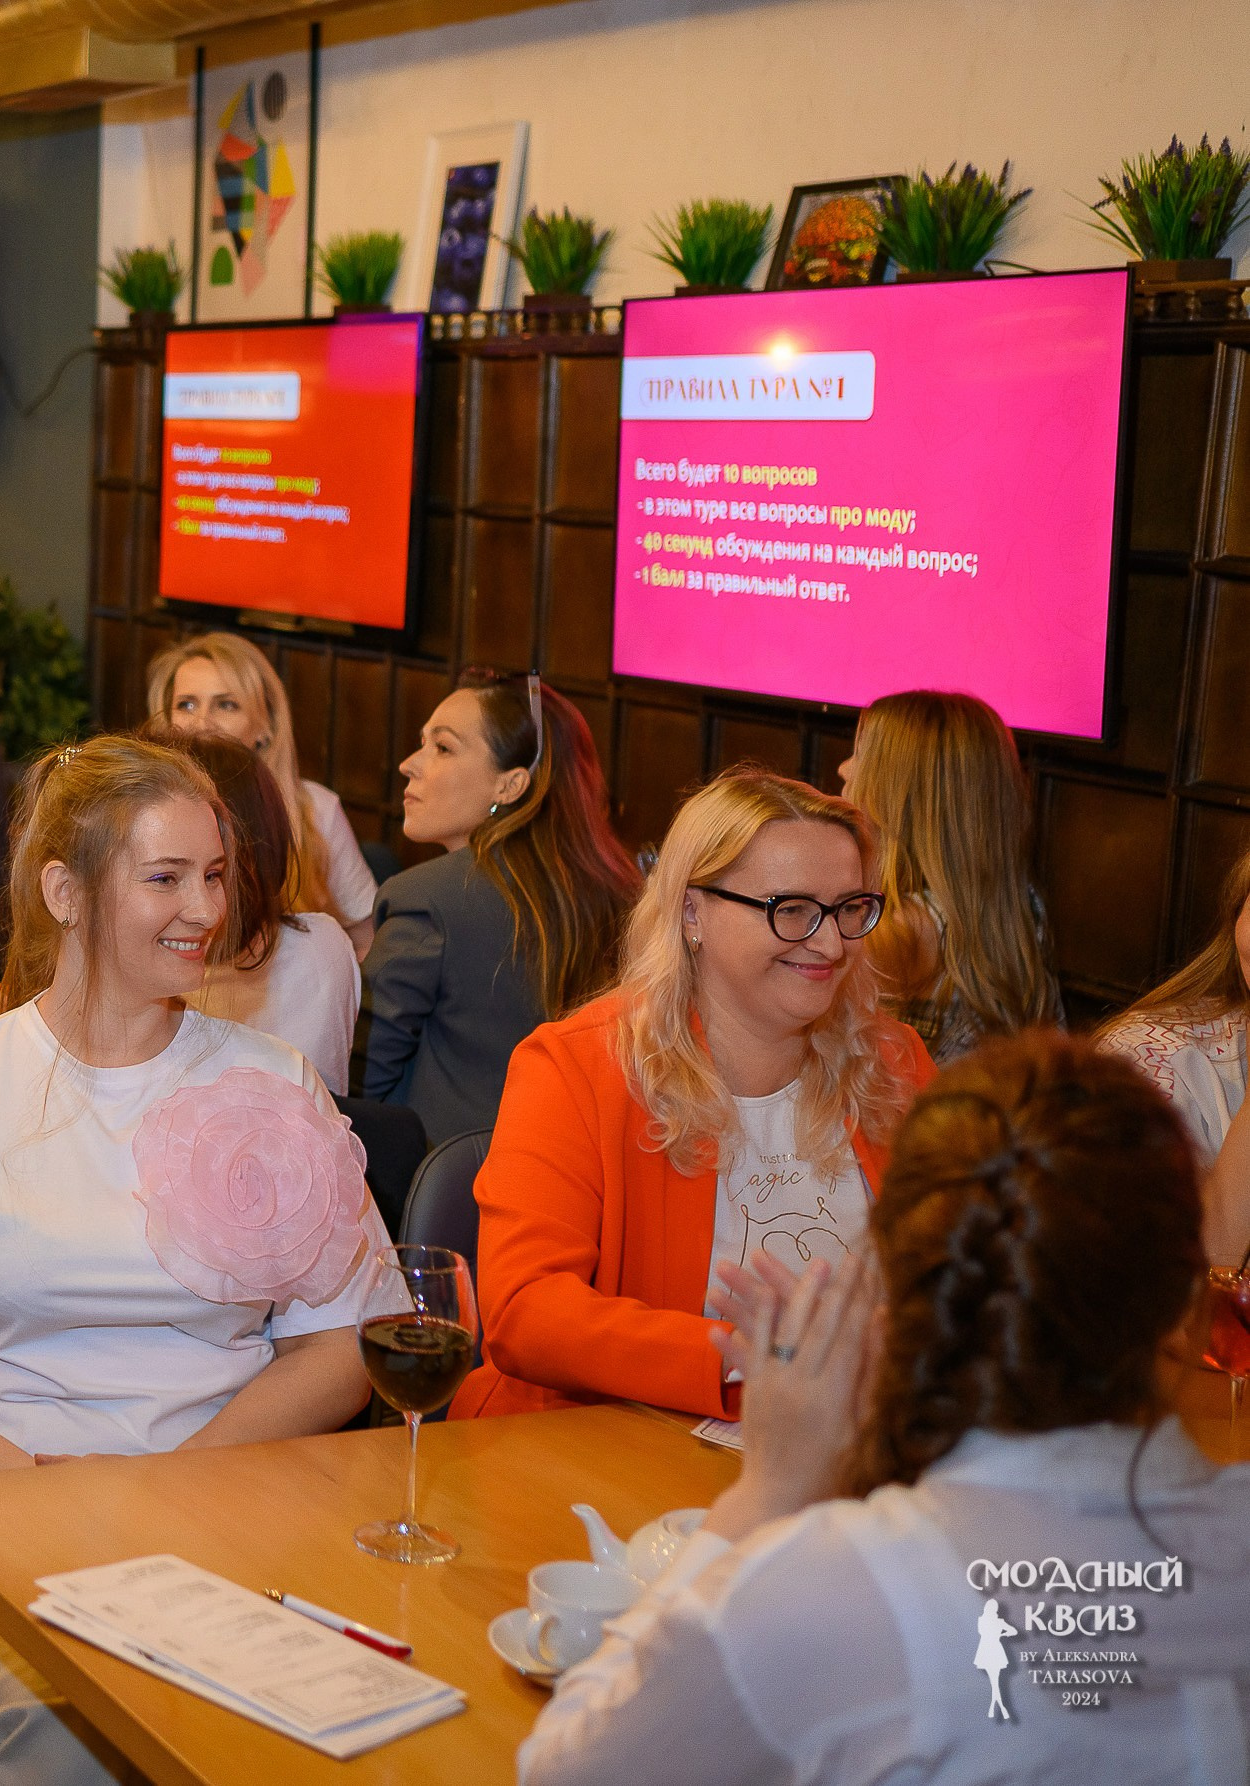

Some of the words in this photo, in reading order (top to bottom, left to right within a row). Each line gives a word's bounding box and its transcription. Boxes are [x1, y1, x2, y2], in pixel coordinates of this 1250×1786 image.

[639, 376, 739, 405] ПРАВИЛА
[749, 376, 800, 401] ТУРА
[635, 457, 677, 482] Всего
[678, 458, 722, 488] будет
[723, 464, 740, 484] 10
[741, 465, 818, 491] вопросов
[656, 497, 692, 518] этом
[693, 499, 728, 524] туре
[729, 501, 756, 521] все
[758, 502, 828, 529] вопросы
[830, 505, 862, 532] про
[865, 507, 917, 535] моду;
[663, 533, 714, 560] секунд
[715, 532, 811, 565] обсуждения
[813, 543, 833, 564] на
[835, 543, 904, 572] каждый
[906, 549, 979, 579] вопрос;
[650, 562, 686, 588] балл
[686, 570, 704, 590] за
[705, 571, 798, 598] правильный
[798, 579, 851, 603] ответ.
